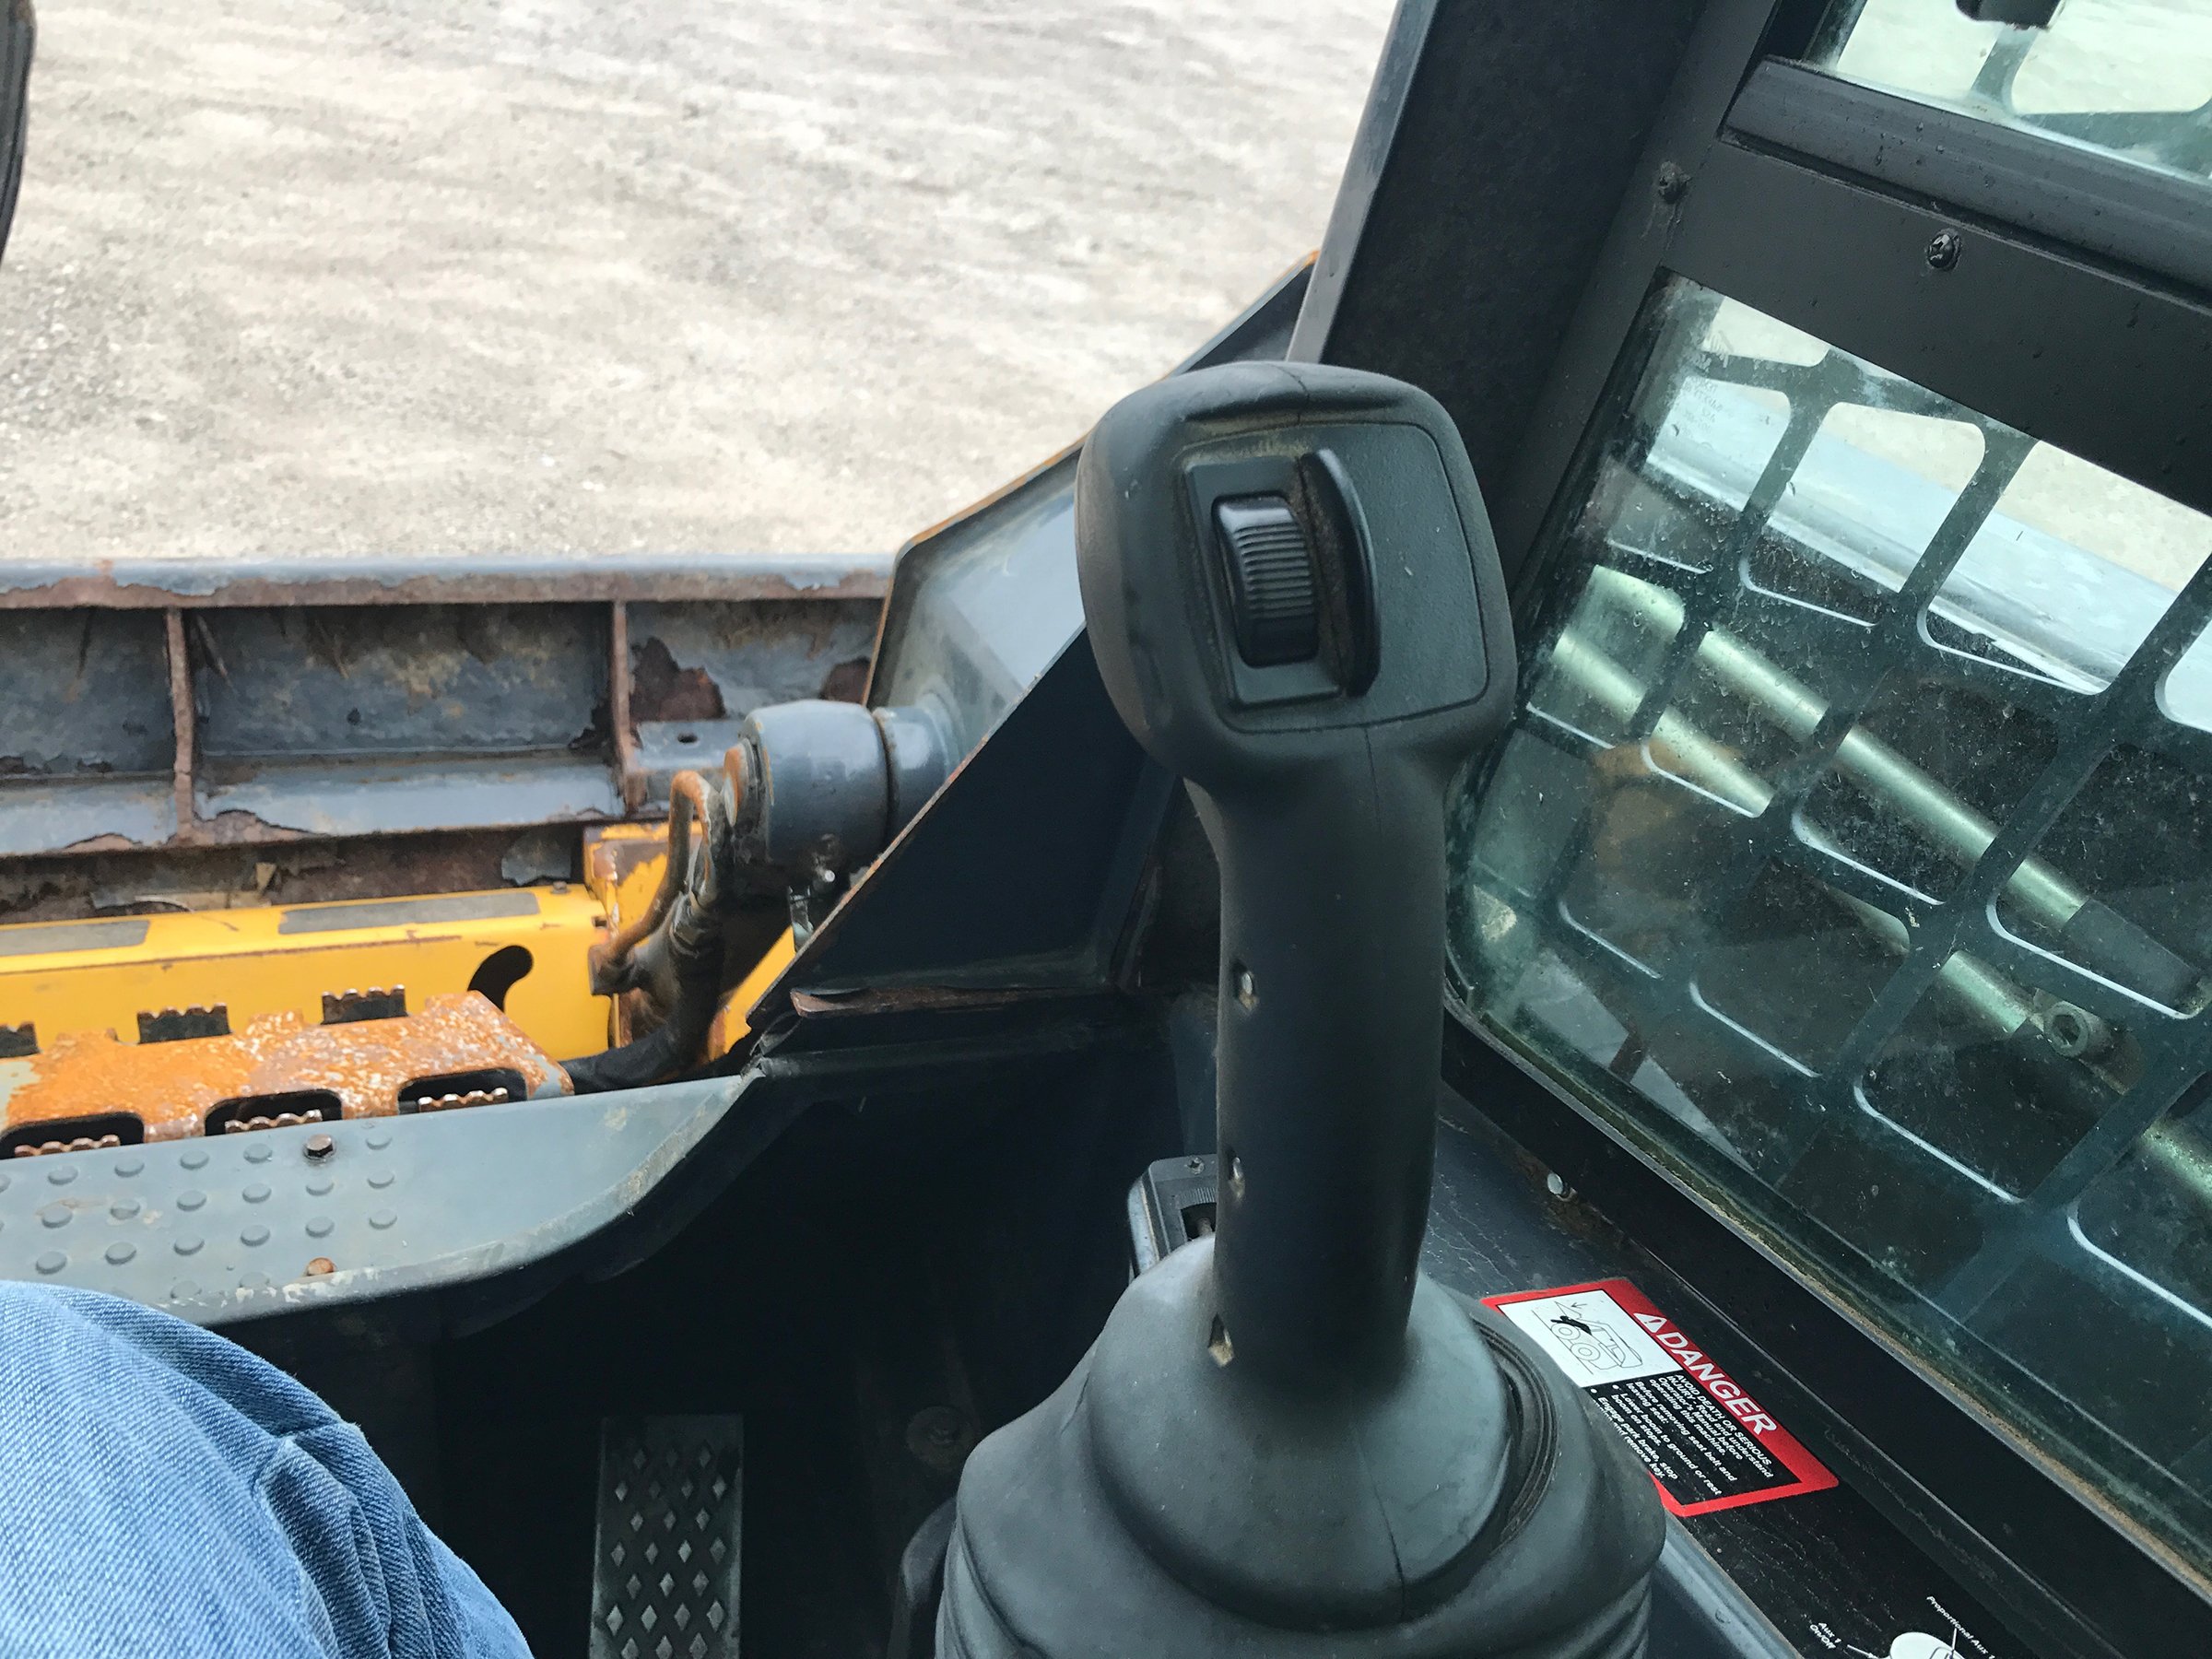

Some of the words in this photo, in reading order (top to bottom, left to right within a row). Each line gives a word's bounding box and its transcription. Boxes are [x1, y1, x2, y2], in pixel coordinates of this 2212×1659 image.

[1619, 1393, 1644, 1414] Lower
[1625, 1383, 1653, 1406] leaving
[1648, 1407, 1669, 1424] seat:
[1656, 1332, 1778, 1435] DANGER
[1596, 1396, 1626, 1422] Engage
[1620, 1422, 1642, 1438] park
[1636, 1439, 1662, 1461] brake,
[1658, 1462, 1680, 1479] stop
[1610, 1394, 1633, 1413] boom
[1628, 1414, 1643, 1423] on
[1638, 1424, 1663, 1446] stops.
[1633, 1381, 1660, 1403] Before
[1656, 1403, 1691, 1435] removing
[1686, 1435, 1707, 1451] seat
[1703, 1451, 1723, 1466] belt
[1717, 1466, 1738, 1481] and
[1639, 1414, 1664, 1434] boom
[1647, 1379, 1683, 1409] operating
[1679, 1409, 1697, 1423] this
[1693, 1424, 1729, 1455] machine.
[1657, 1377, 1696, 1410] Operator's
[1690, 1411, 1722, 1436] Manual
[1716, 1436, 1745, 1460] before
[1659, 1434, 1672, 1442] to
[1665, 1375, 1696, 1400] INJURY
[1694, 1404, 1718, 1422] Read
[1713, 1423, 1733, 1436] and
[1727, 1437, 1774, 1477] understand
[1674, 1374, 1701, 1395] AVOID
[1696, 1395, 1726, 1419] DEATH
[1720, 1419, 1738, 1431] OR
[1733, 1431, 1773, 1465] SERIOUS
[1623, 1436, 1652, 1462] remove
[1648, 1463, 1665, 1478] key.
[1665, 1443, 1699, 1469] ground
[1693, 1469, 1707, 1478] or
[1702, 1479, 1724, 1494] rest
[1818, 1623, 1835, 1638] Aux
[1926, 1596, 1974, 1639] Proportional
[1971, 1640, 1988, 1654] Aux
